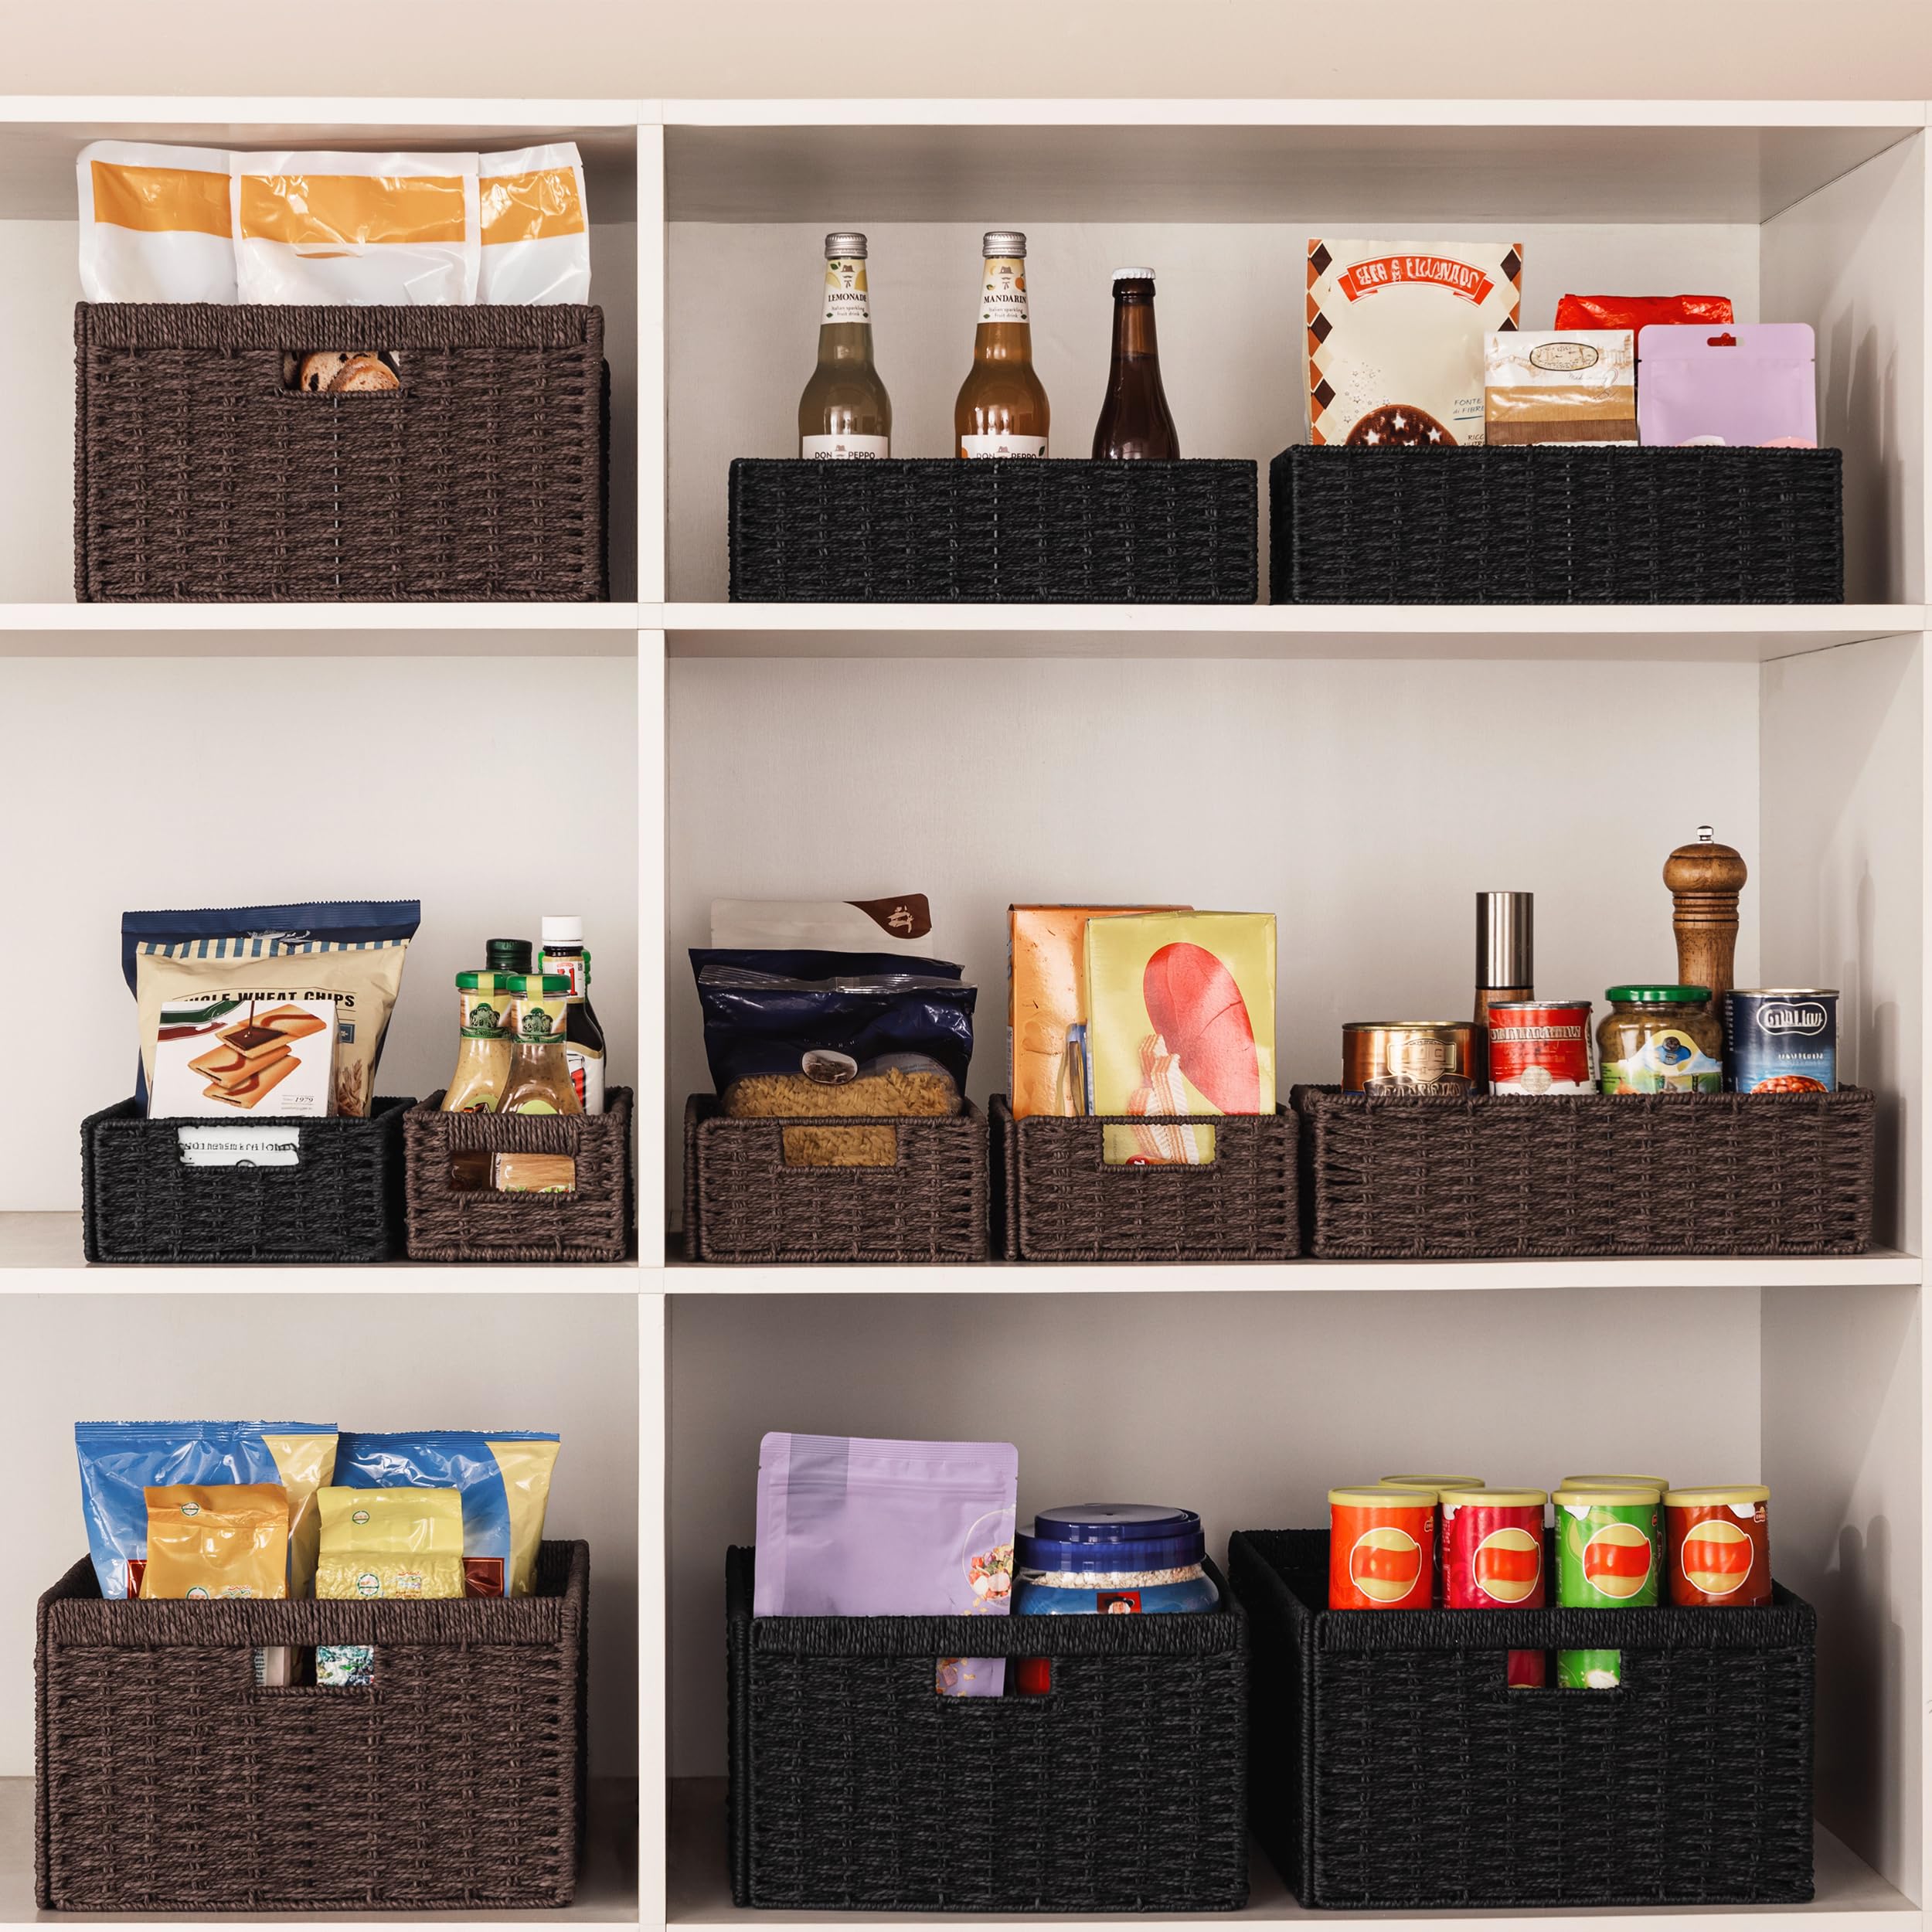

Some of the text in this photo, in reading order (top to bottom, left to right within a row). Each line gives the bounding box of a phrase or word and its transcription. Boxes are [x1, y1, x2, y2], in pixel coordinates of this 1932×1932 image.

[828, 293, 866, 302] LEMONADE
[984, 294, 1026, 304] MANDARIN
[1454, 397, 1481, 406] FONTE
[238, 992, 298, 1002] WHEAT
[304, 991, 355, 1007] CHIPS
